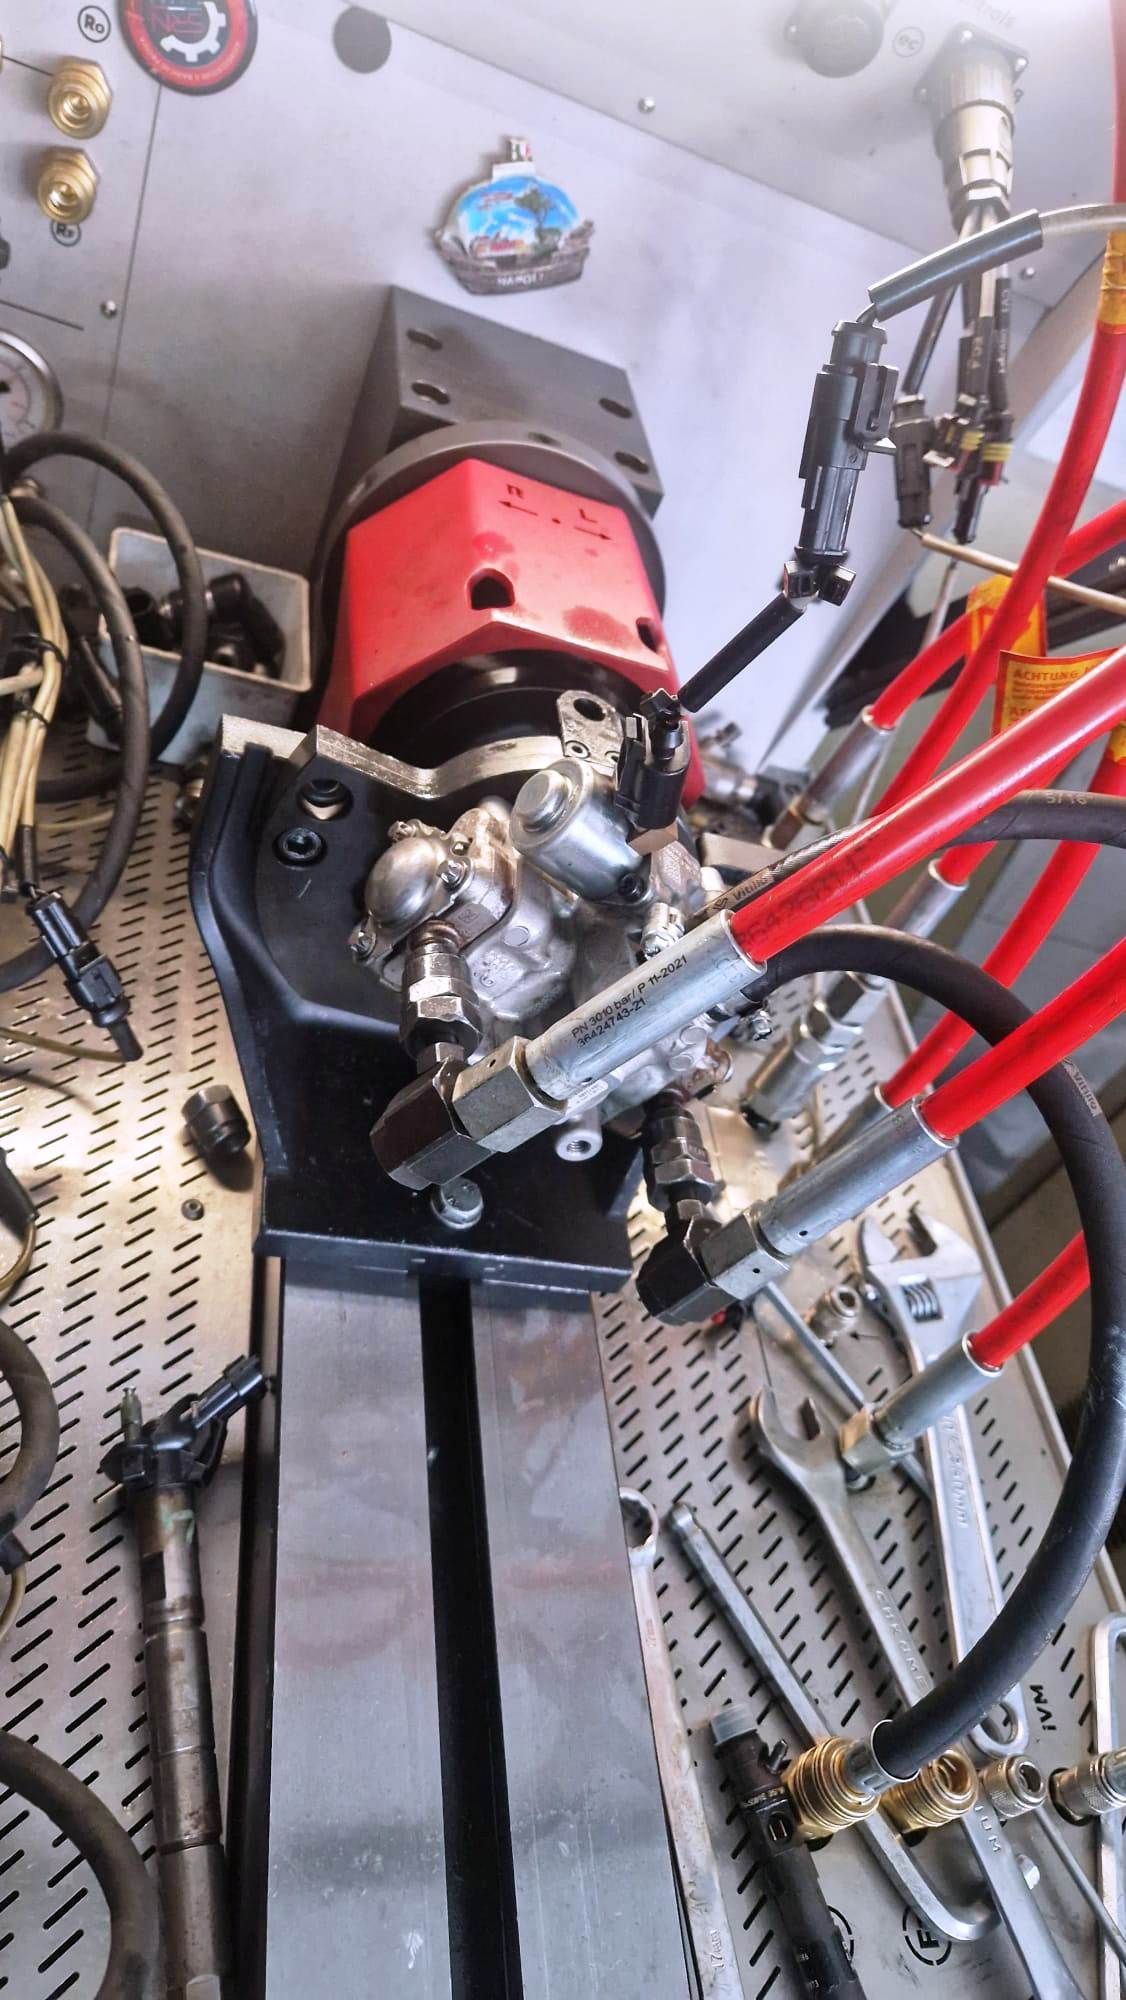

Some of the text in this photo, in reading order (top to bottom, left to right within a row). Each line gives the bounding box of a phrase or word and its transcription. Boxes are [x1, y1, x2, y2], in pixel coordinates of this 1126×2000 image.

[571, 1024, 589, 1039] PN
[588, 1005, 613, 1026] 3010
[637, 982, 647, 994] P
[647, 954, 688, 986] 11-2021
[576, 997, 647, 1049] 36424743-21
[875, 1589, 931, 1690] CHROME
[974, 1804, 1001, 1852] IUM
